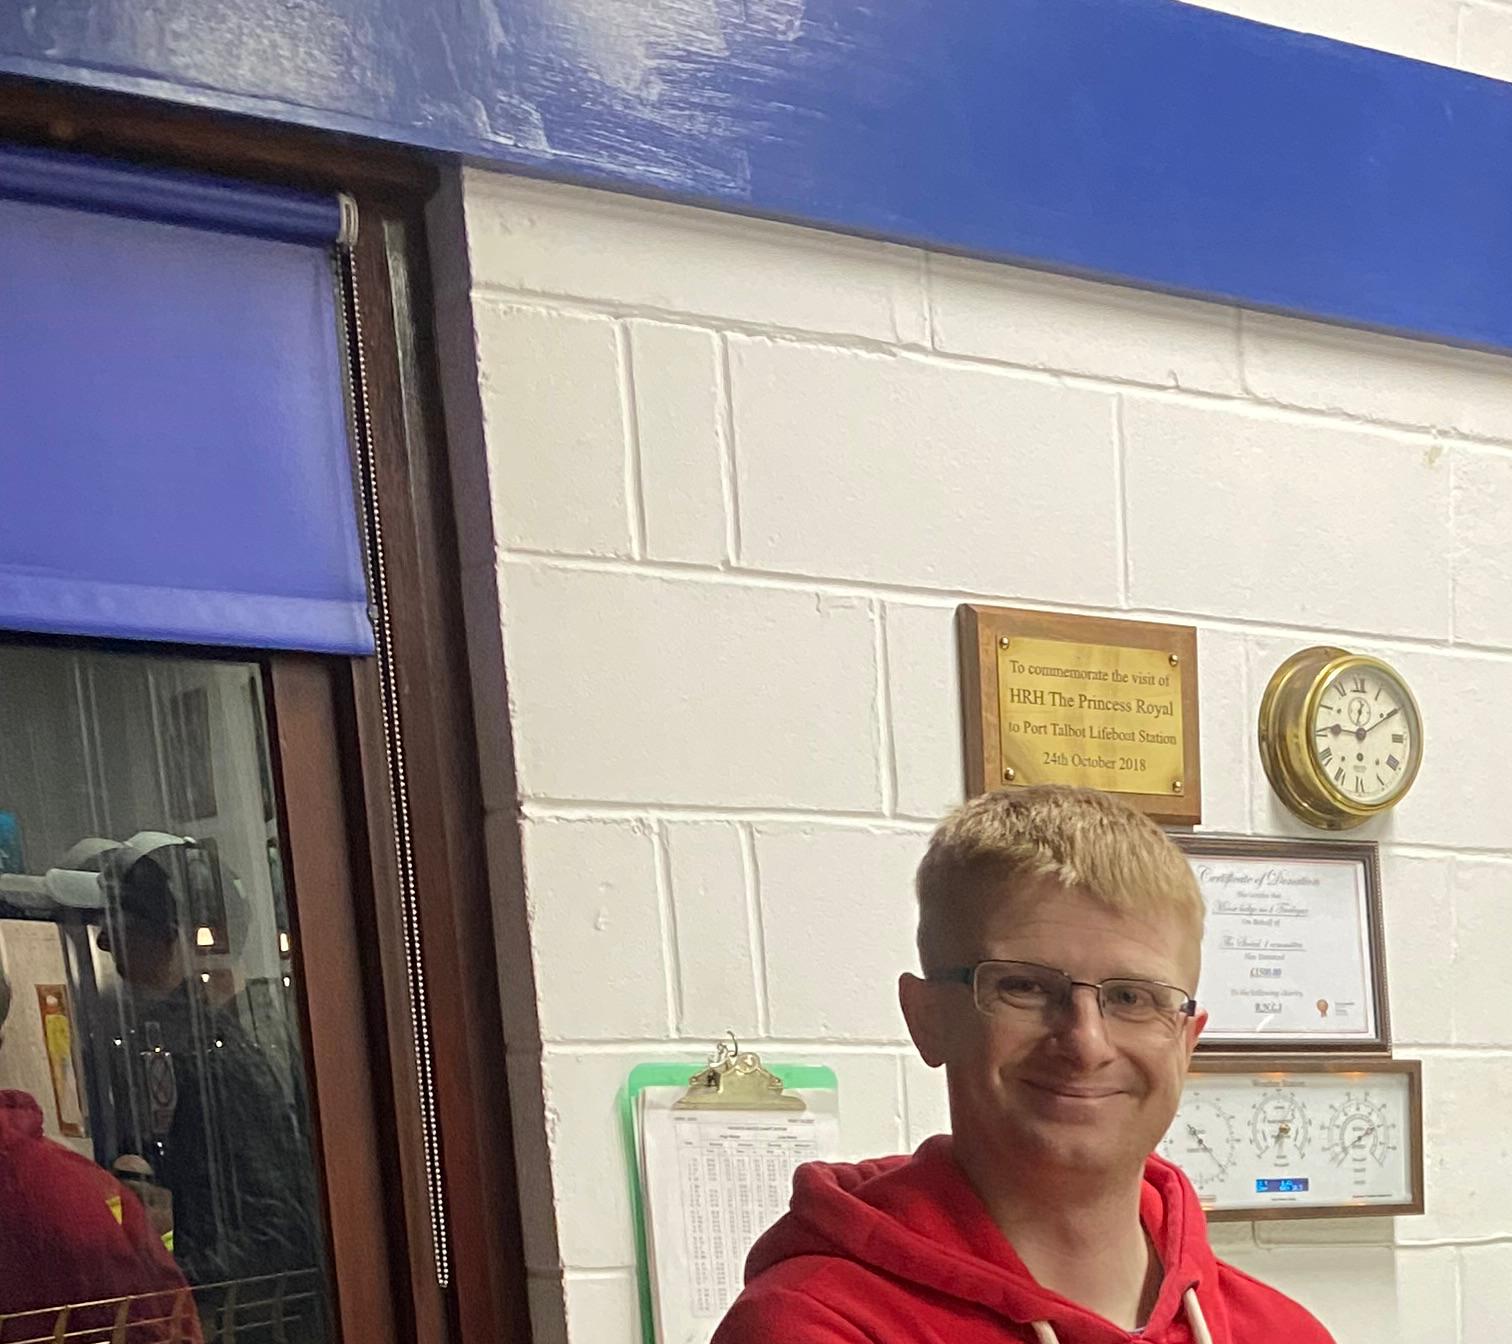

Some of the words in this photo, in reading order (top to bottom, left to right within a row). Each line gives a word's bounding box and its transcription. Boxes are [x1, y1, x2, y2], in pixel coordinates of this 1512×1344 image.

[1009, 660, 1025, 674] To
[1028, 665, 1108, 682] commemorate
[1112, 669, 1128, 683] the
[1132, 672, 1155, 685] visit
[1159, 676, 1169, 687] of
[1009, 688, 1046, 706] HRH
[1048, 692, 1075, 708] The
[1078, 694, 1132, 712] Princess
[1135, 699, 1173, 718] Royal
[1008, 722, 1020, 733] to
[1023, 721, 1047, 735] Port
[1050, 723, 1086, 738] Talbot
[1089, 726, 1136, 742] Lifeboat
[1138, 731, 1177, 745] Station
[1043, 752, 1069, 766] 24th
[1072, 754, 1116, 769] October
[1119, 757, 1147, 771] 2018
[1198, 864, 1253, 887] Certificate
[1254, 871, 1266, 889] of
[1266, 869, 1320, 886] Donation
